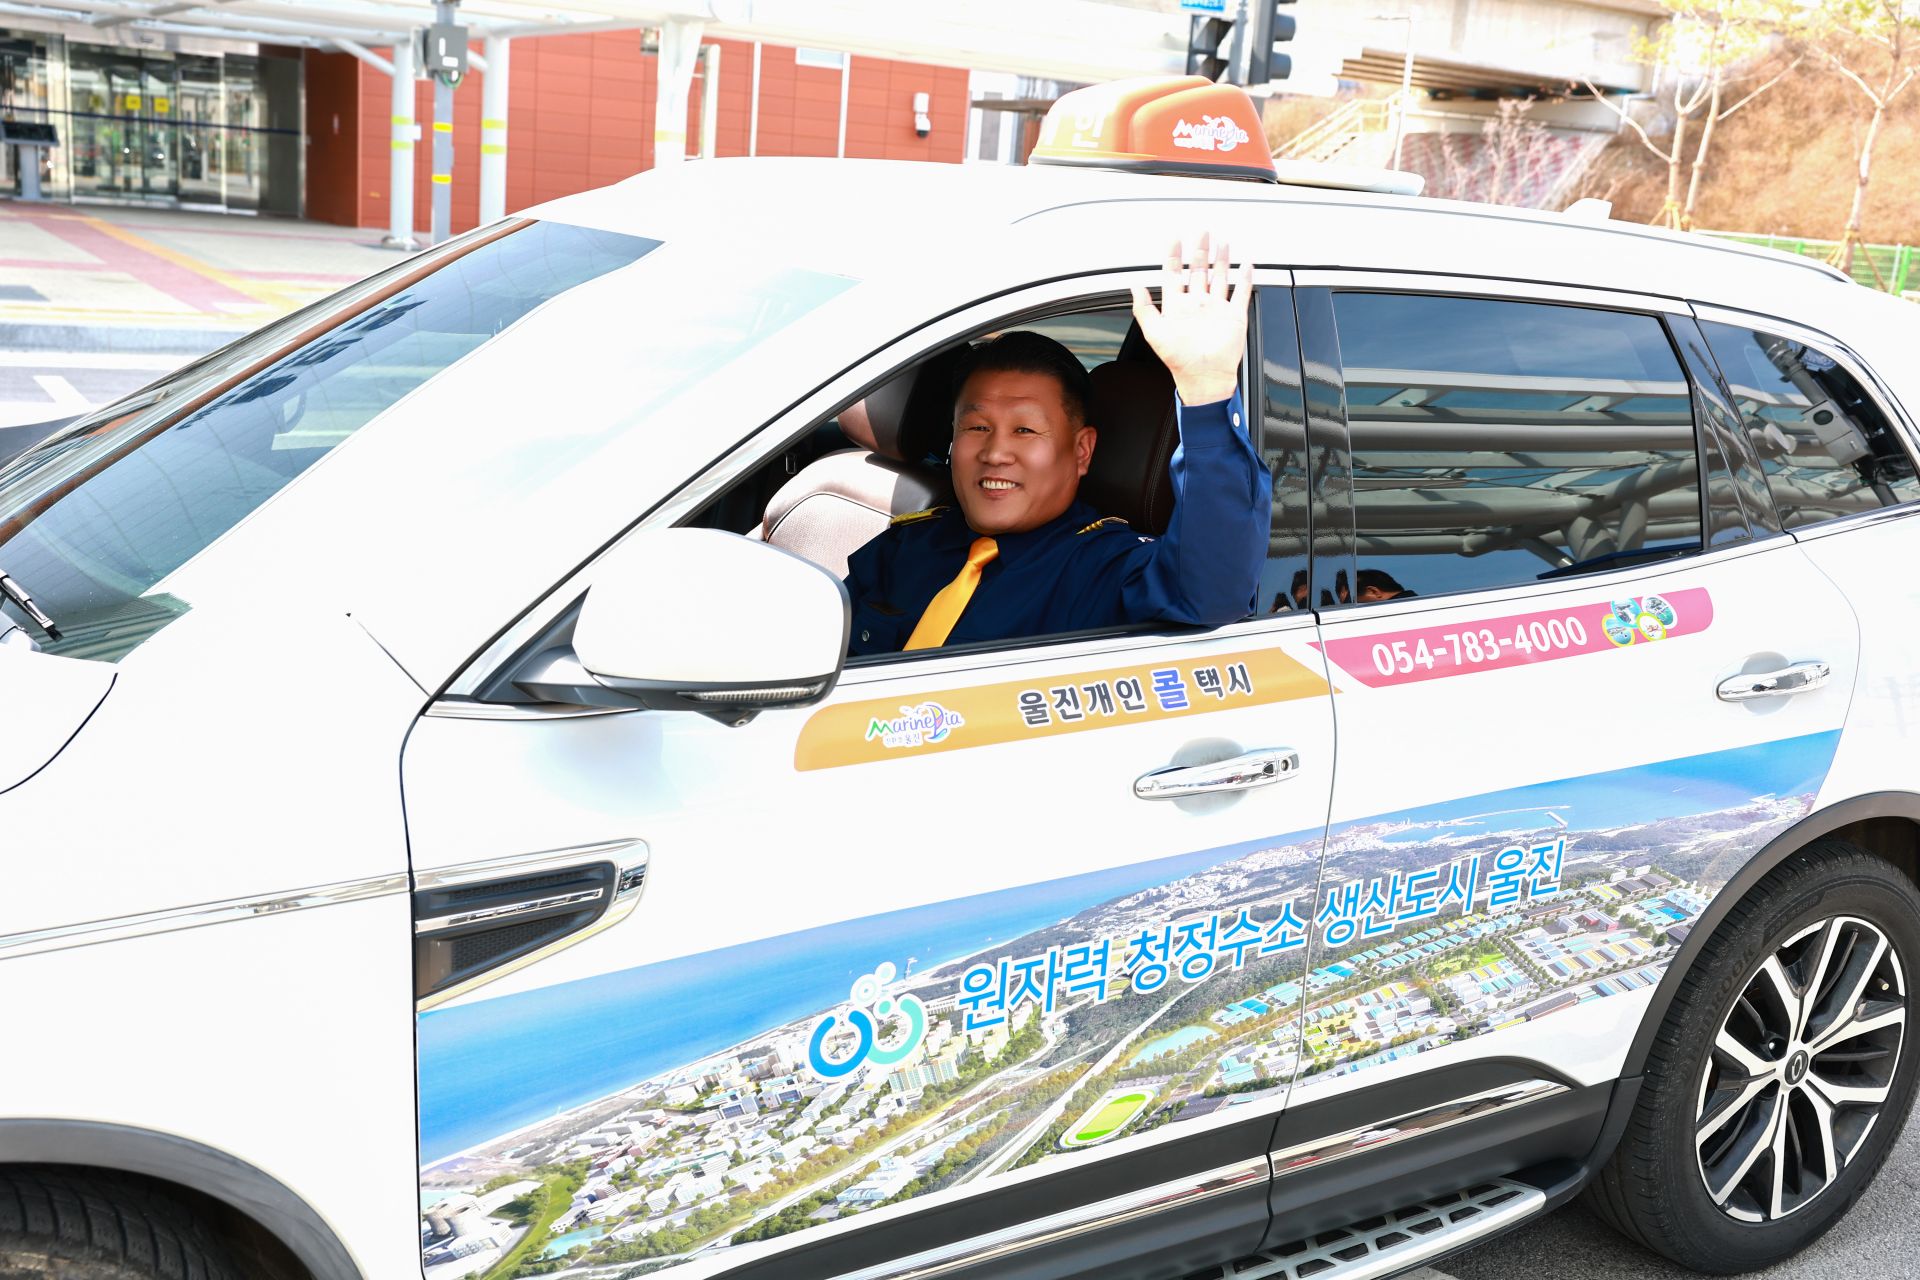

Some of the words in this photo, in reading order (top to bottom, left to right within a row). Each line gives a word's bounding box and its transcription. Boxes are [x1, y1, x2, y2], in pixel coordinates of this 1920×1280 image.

[1371, 616, 1587, 676] 054-783-4000
[1019, 678, 1145, 725] 울진개인
[1152, 669, 1188, 709] 콜
[1194, 664, 1252, 698] 택시
[958, 939, 1110, 1031] 원자력
[1126, 902, 1304, 991] 청정수소
[1318, 857, 1478, 944] 생산도시
[1488, 839, 1565, 907] 울진
